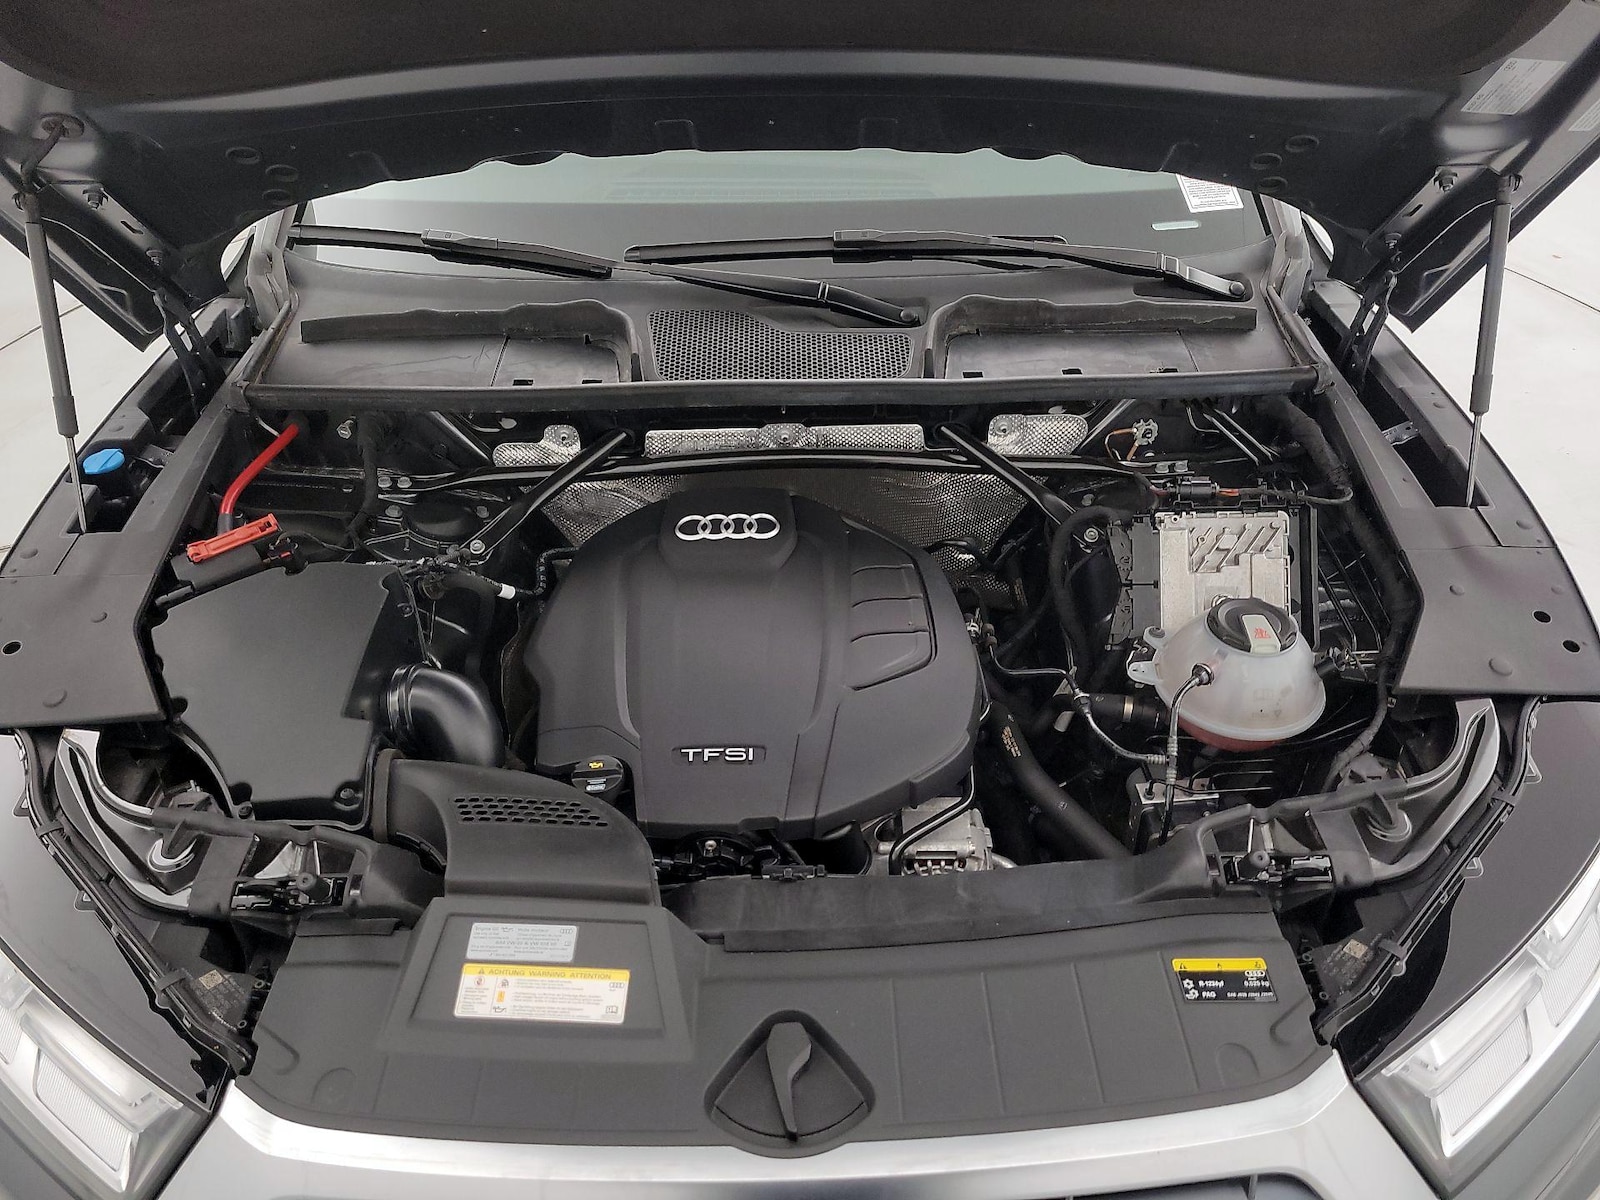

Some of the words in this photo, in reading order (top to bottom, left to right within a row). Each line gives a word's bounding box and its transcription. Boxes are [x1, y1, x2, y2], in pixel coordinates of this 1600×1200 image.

[680, 747, 754, 762] TFSI
[529, 970, 566, 978] WARNING
[569, 972, 611, 980] ATTENTION
